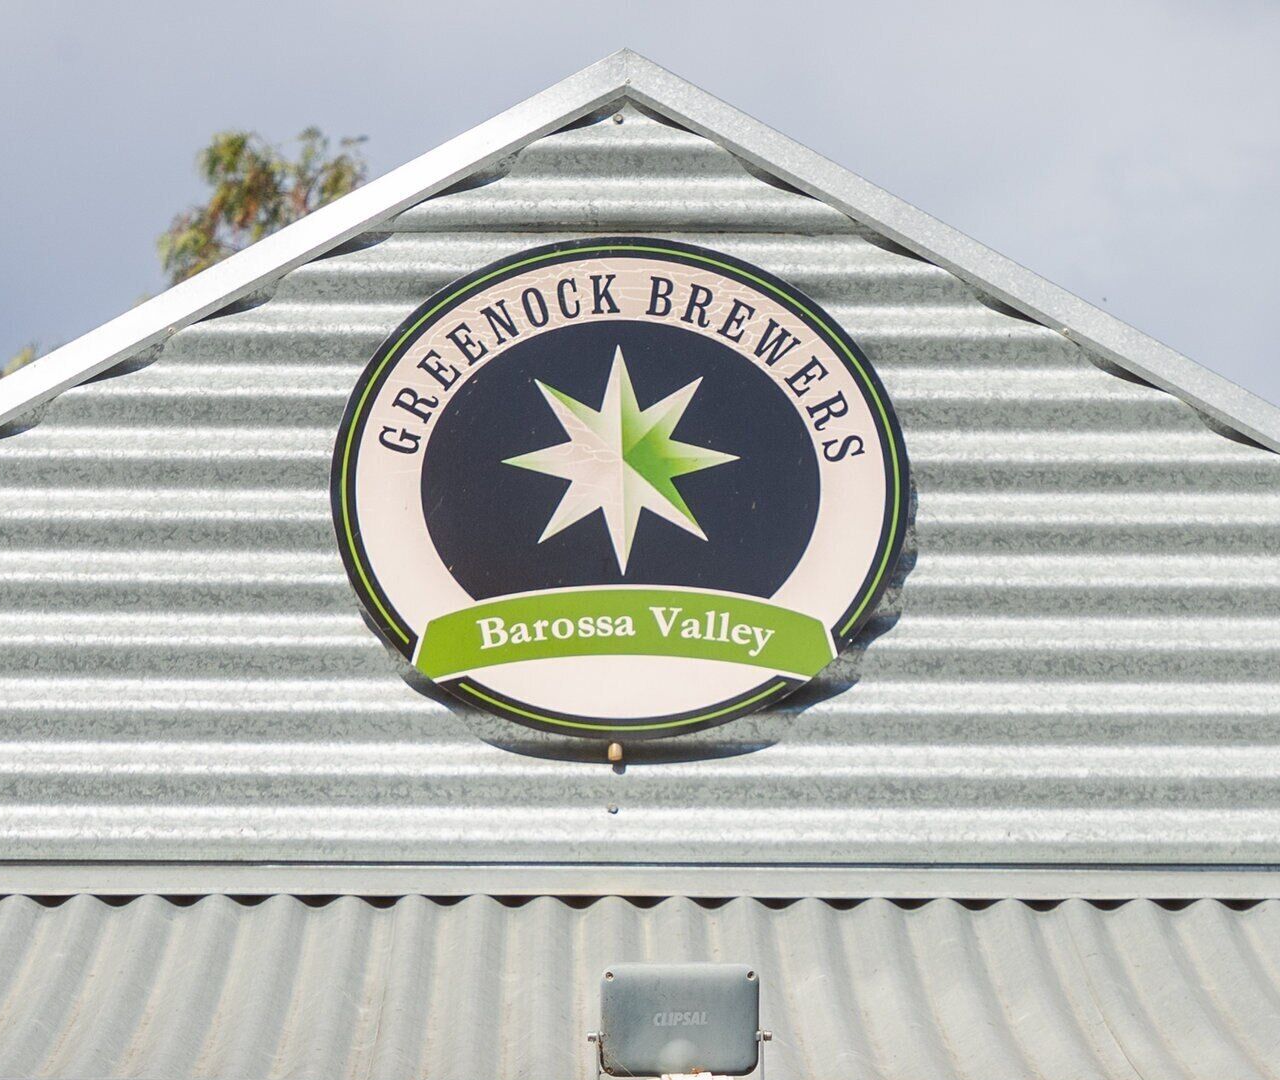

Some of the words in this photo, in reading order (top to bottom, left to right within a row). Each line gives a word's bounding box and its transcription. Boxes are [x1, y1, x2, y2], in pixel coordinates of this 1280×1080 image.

[378, 273, 621, 455] GREENOCK
[645, 275, 866, 463] BREWERS
[475, 614, 637, 650] Barossa
[648, 606, 776, 657] Valley
[652, 1010, 709, 1027] CLIPSAL
